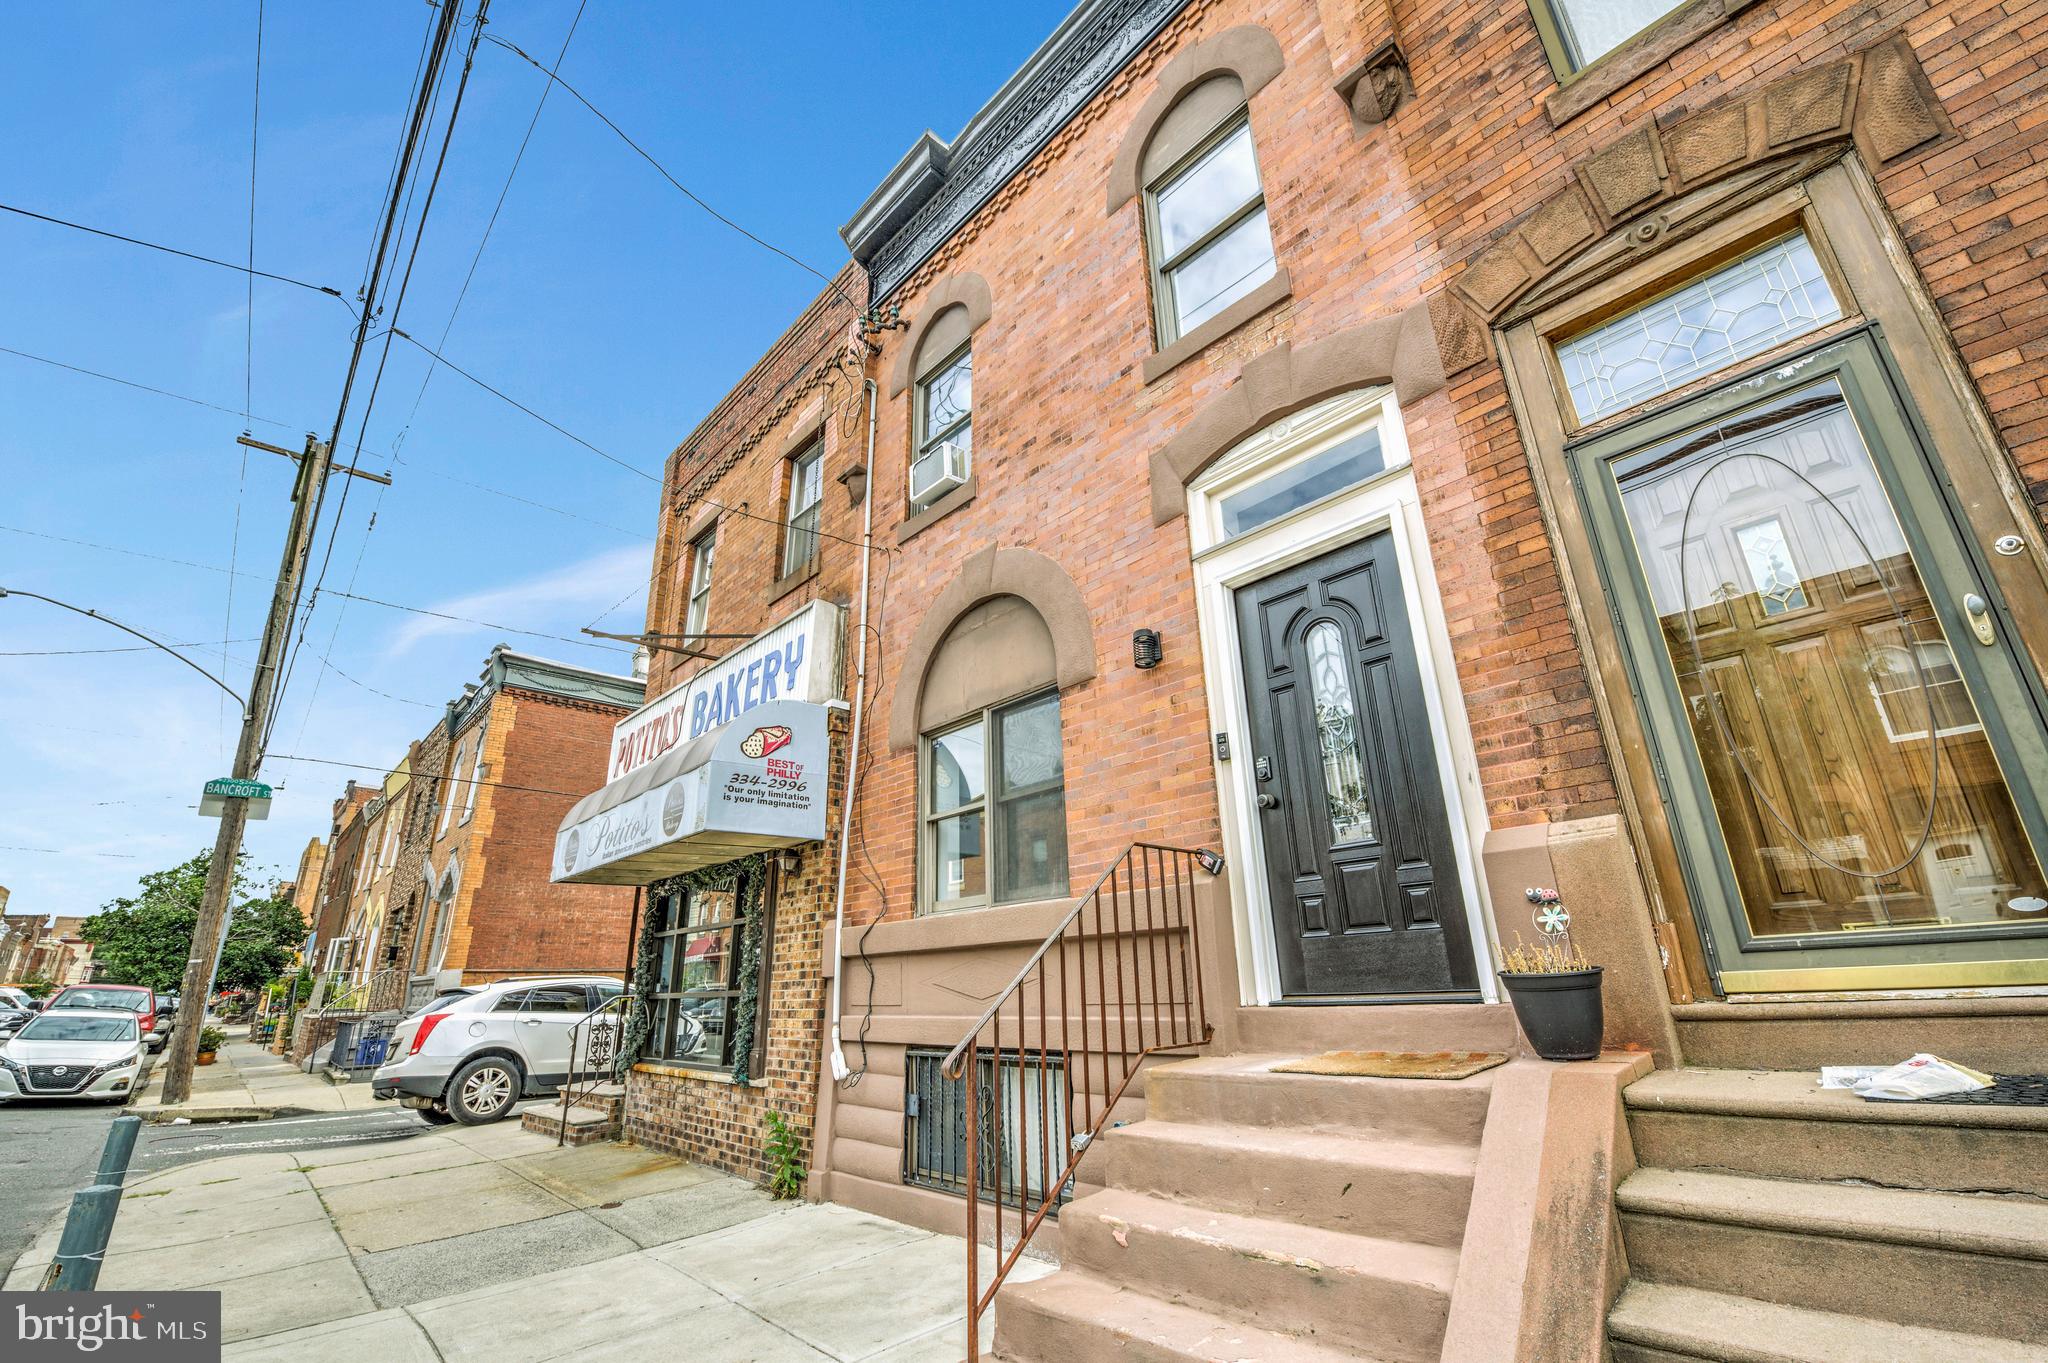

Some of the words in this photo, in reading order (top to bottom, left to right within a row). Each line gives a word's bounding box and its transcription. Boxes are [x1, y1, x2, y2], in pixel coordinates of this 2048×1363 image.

[613, 704, 684, 779] POTITO'S
[690, 633, 805, 740] BAKERY
[767, 758, 795, 769] BEST
[729, 773, 808, 792] 334-2996
[766, 768, 802, 780] PHILLY
[206, 783, 262, 797] BANCROFT
[724, 784, 744, 794] "Our
[747, 787, 766, 798] only
[768, 790, 810, 802] limitation
[723, 793, 732, 801] is
[734, 795, 754, 804] your
[757, 796, 811, 810] imagination"
